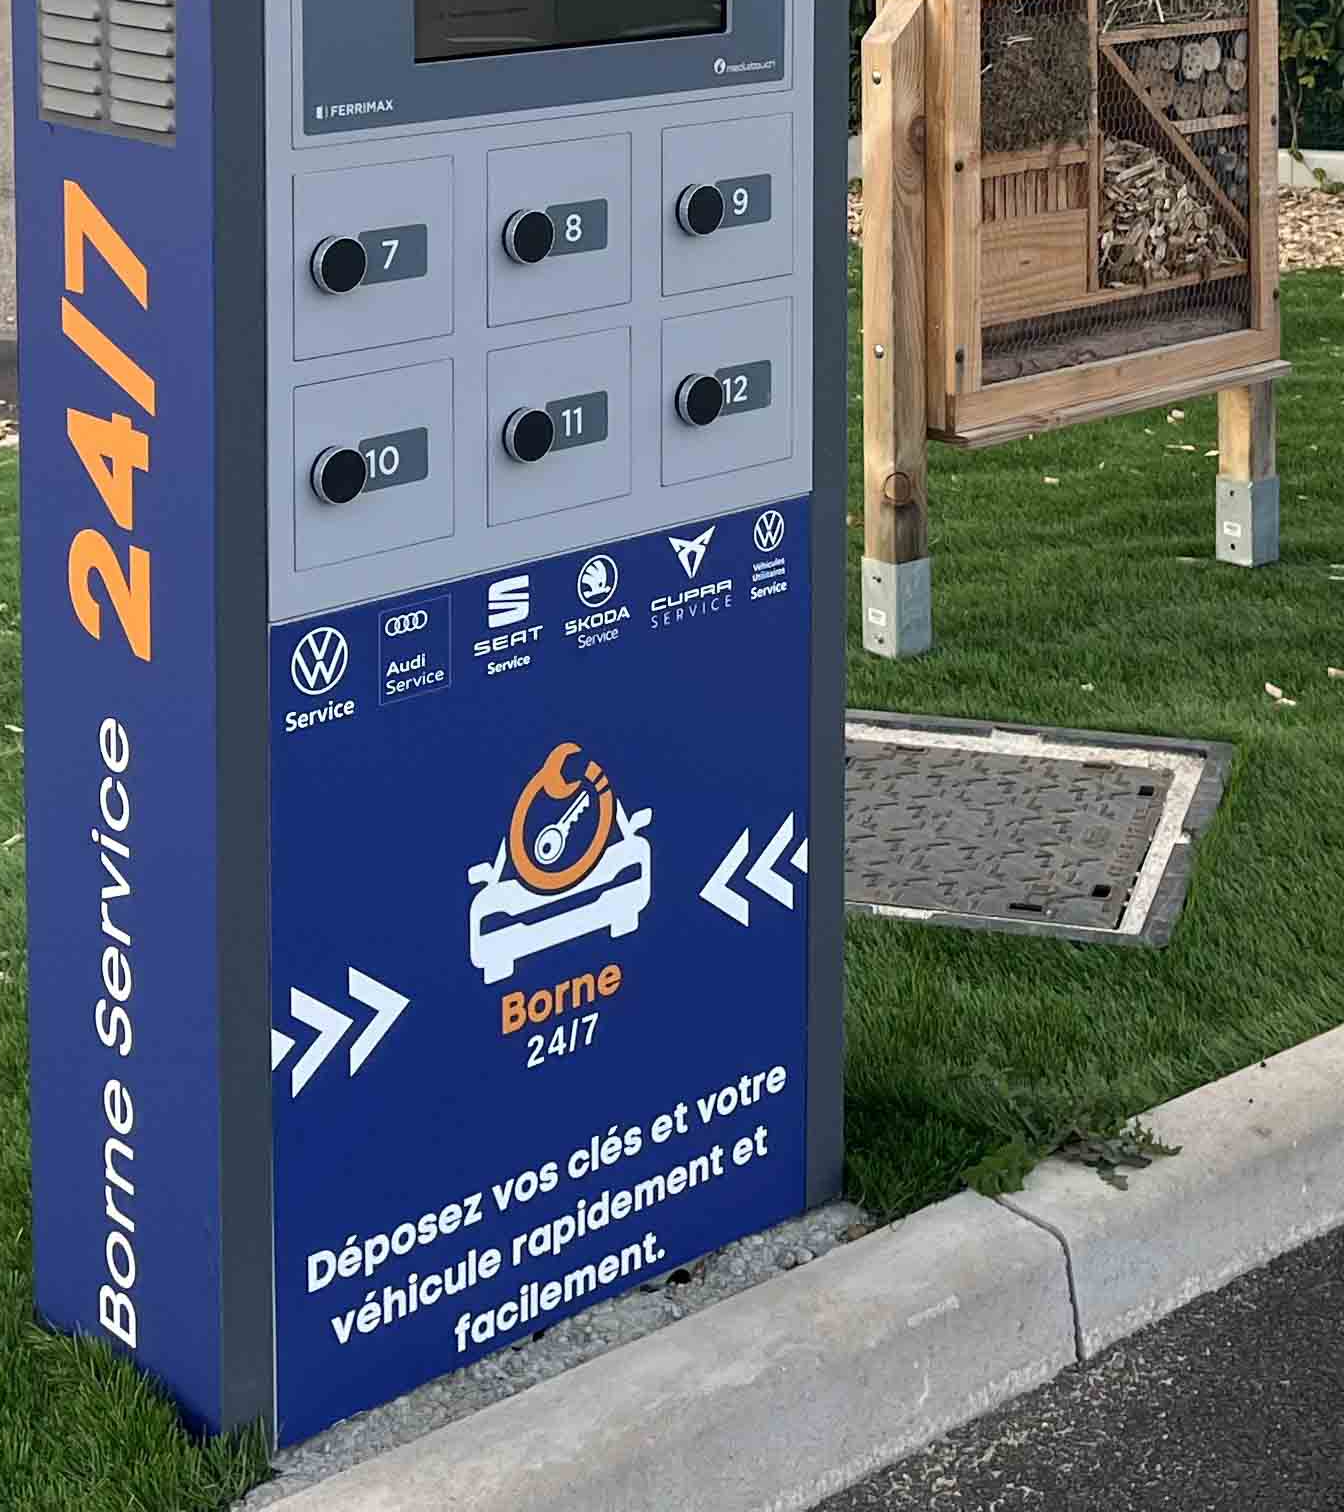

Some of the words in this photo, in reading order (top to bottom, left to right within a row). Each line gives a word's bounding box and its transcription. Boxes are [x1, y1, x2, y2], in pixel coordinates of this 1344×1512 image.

[330, 99, 394, 117] FERRIMAX
[732, 188, 748, 215] 9
[565, 214, 582, 242] 8
[382, 239, 399, 269] 7
[722, 375, 748, 404] 12
[61, 178, 156, 662] 24/7
[561, 407, 582, 437] 11
[365, 446, 400, 478] 10
[650, 579, 733, 612] CUPRA
[750, 581, 788, 600] Service
[650, 596, 733, 629] SERVICE
[473, 624, 544, 657] SEAT
[577, 627, 619, 649] Service
[385, 652, 426, 677] Audi
[487, 654, 531, 676] Service
[385, 669, 445, 696] Service
[285, 699, 355, 733] Service
[92, 717, 135, 1057] Service
[501, 963, 622, 1035] Borne
[526, 1012, 600, 1068] 24/7
[307, 1192, 483, 1294] Déposez
[492, 1160, 559, 1213] vos
[567, 1123, 643, 1180] clés
[650, 1101, 689, 1144] et
[696, 1065, 787, 1125] votre
[99, 1079, 138, 1350] Borne
[330, 1246, 503, 1346] véhicule
[511, 1142, 724, 1267] rapidement
[732, 1124, 769, 1168] et
[454, 1231, 667, 1354] facilement.
